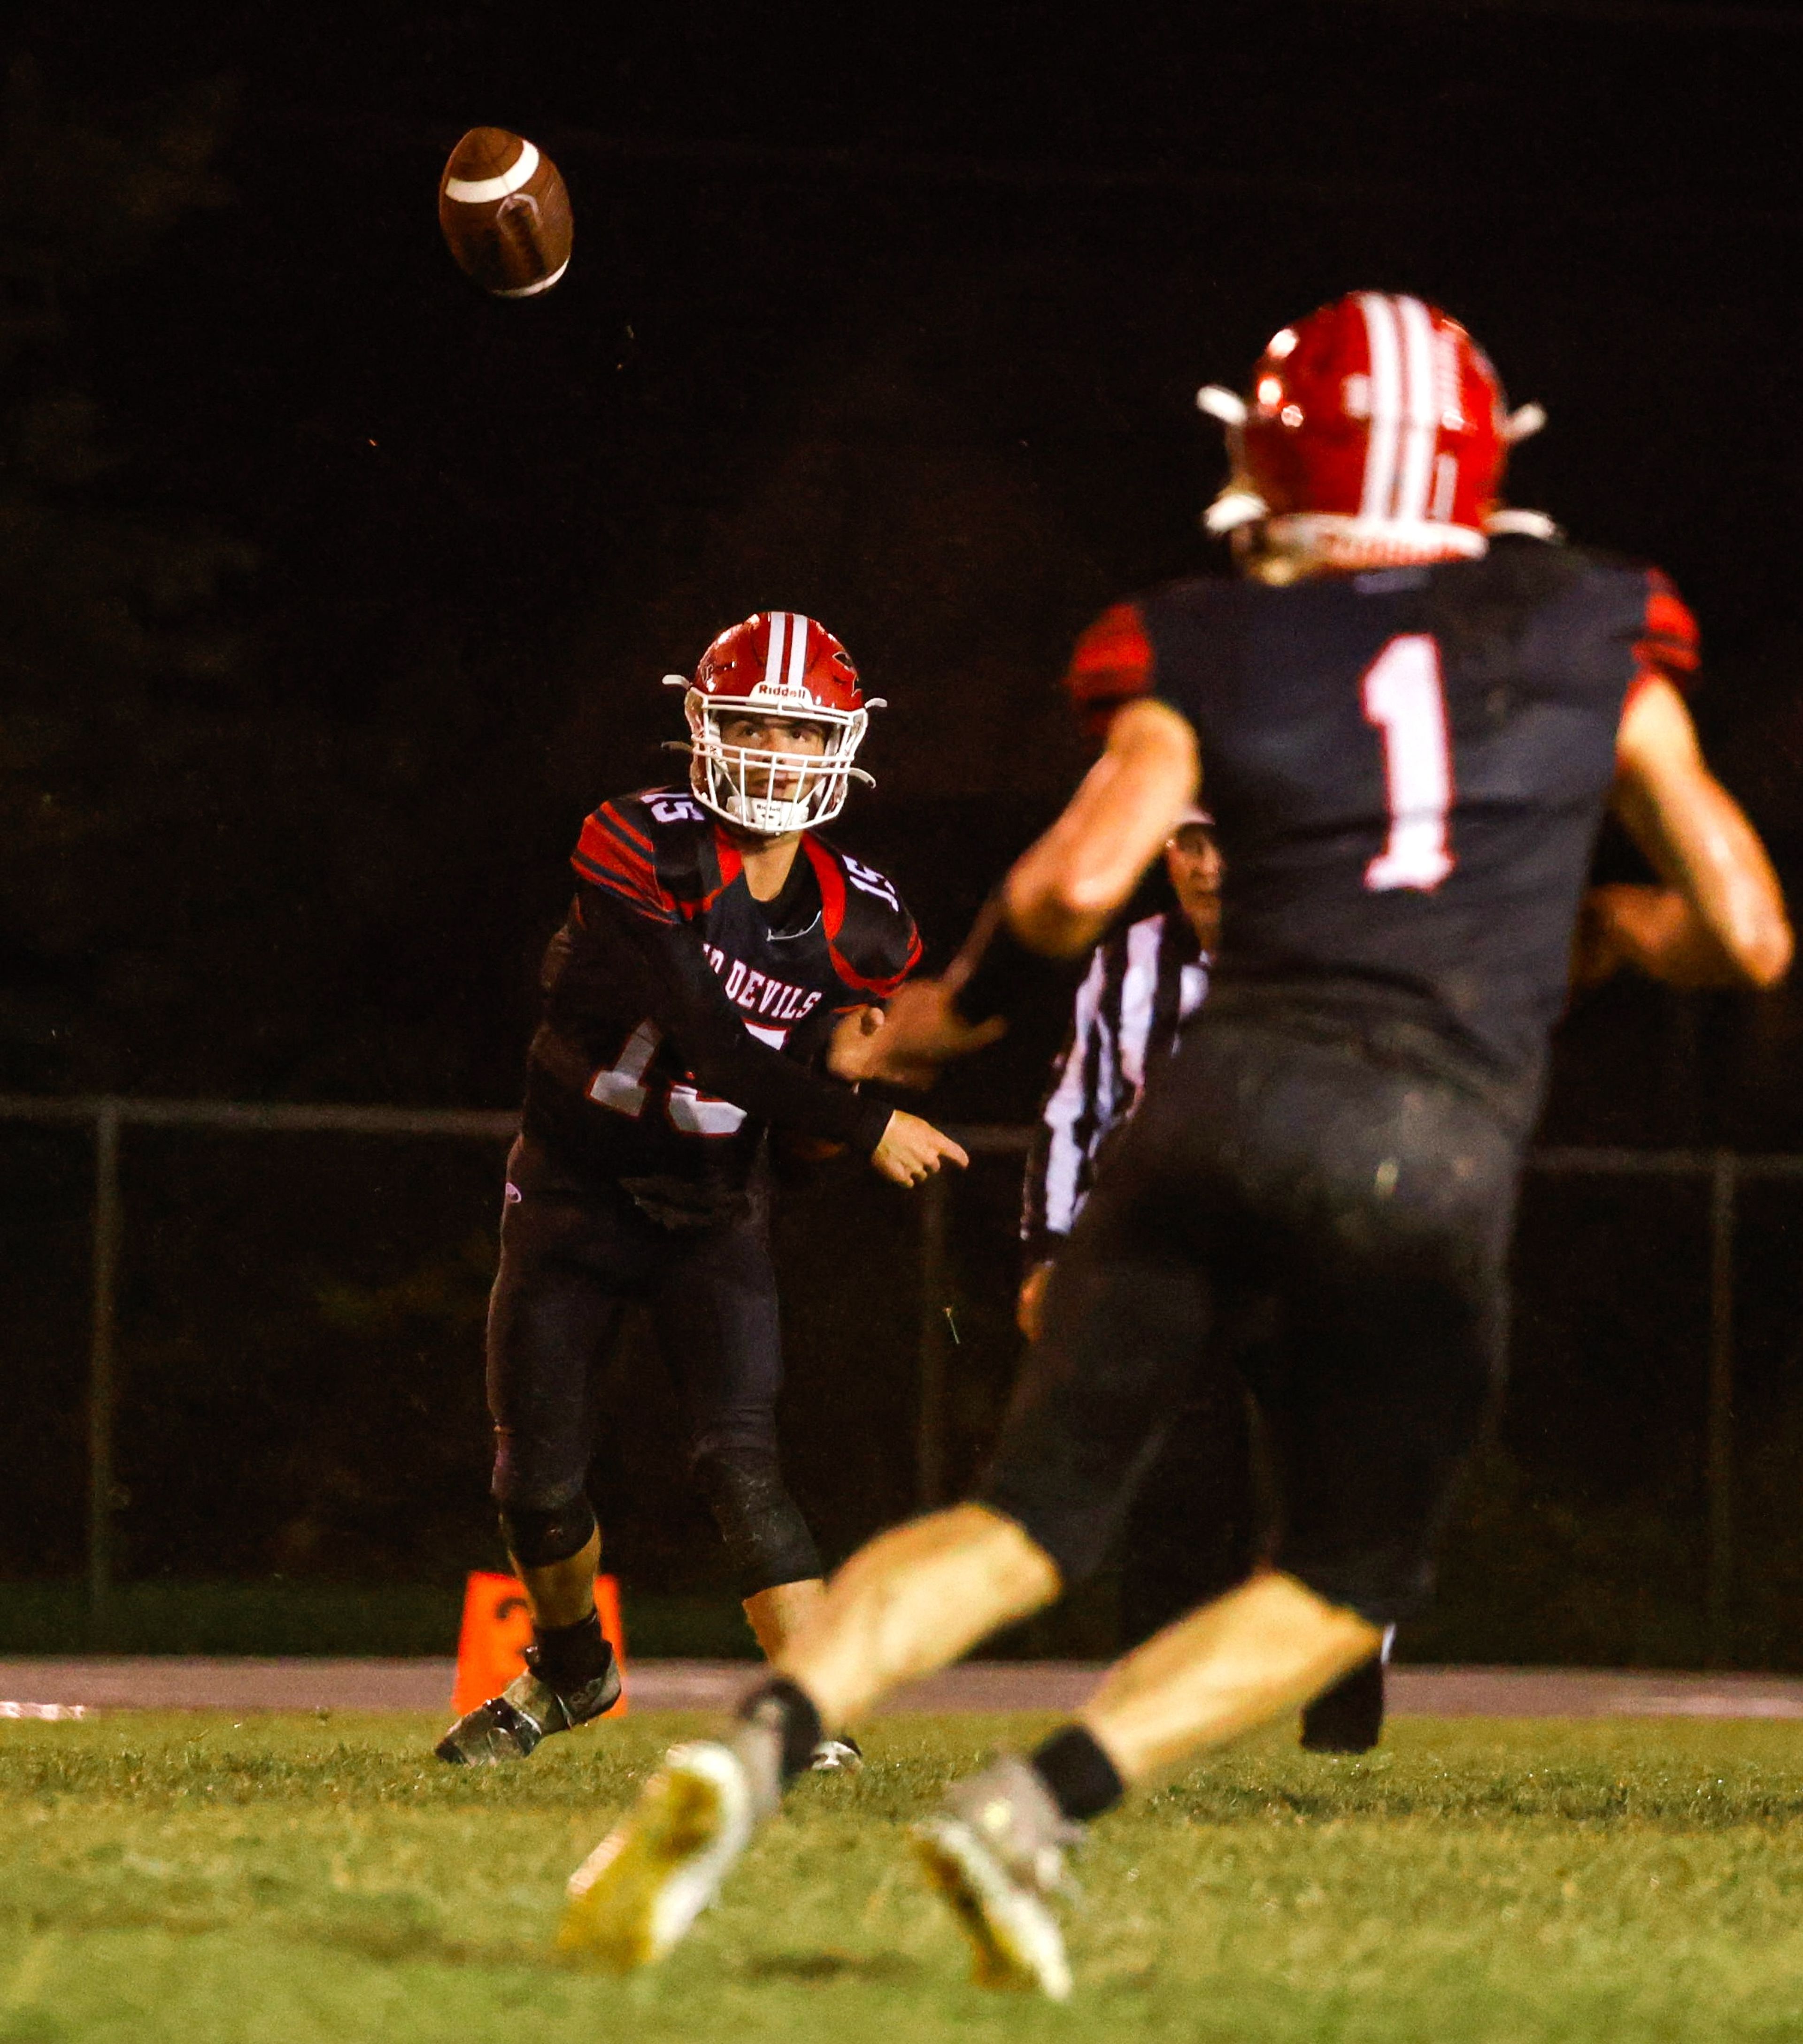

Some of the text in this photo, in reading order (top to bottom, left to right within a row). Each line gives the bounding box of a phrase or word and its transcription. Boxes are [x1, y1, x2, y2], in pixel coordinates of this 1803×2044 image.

[759, 684, 806, 699] Riddell
[1359, 632, 1457, 894] 1
[724, 957, 825, 1019] DEVILS
